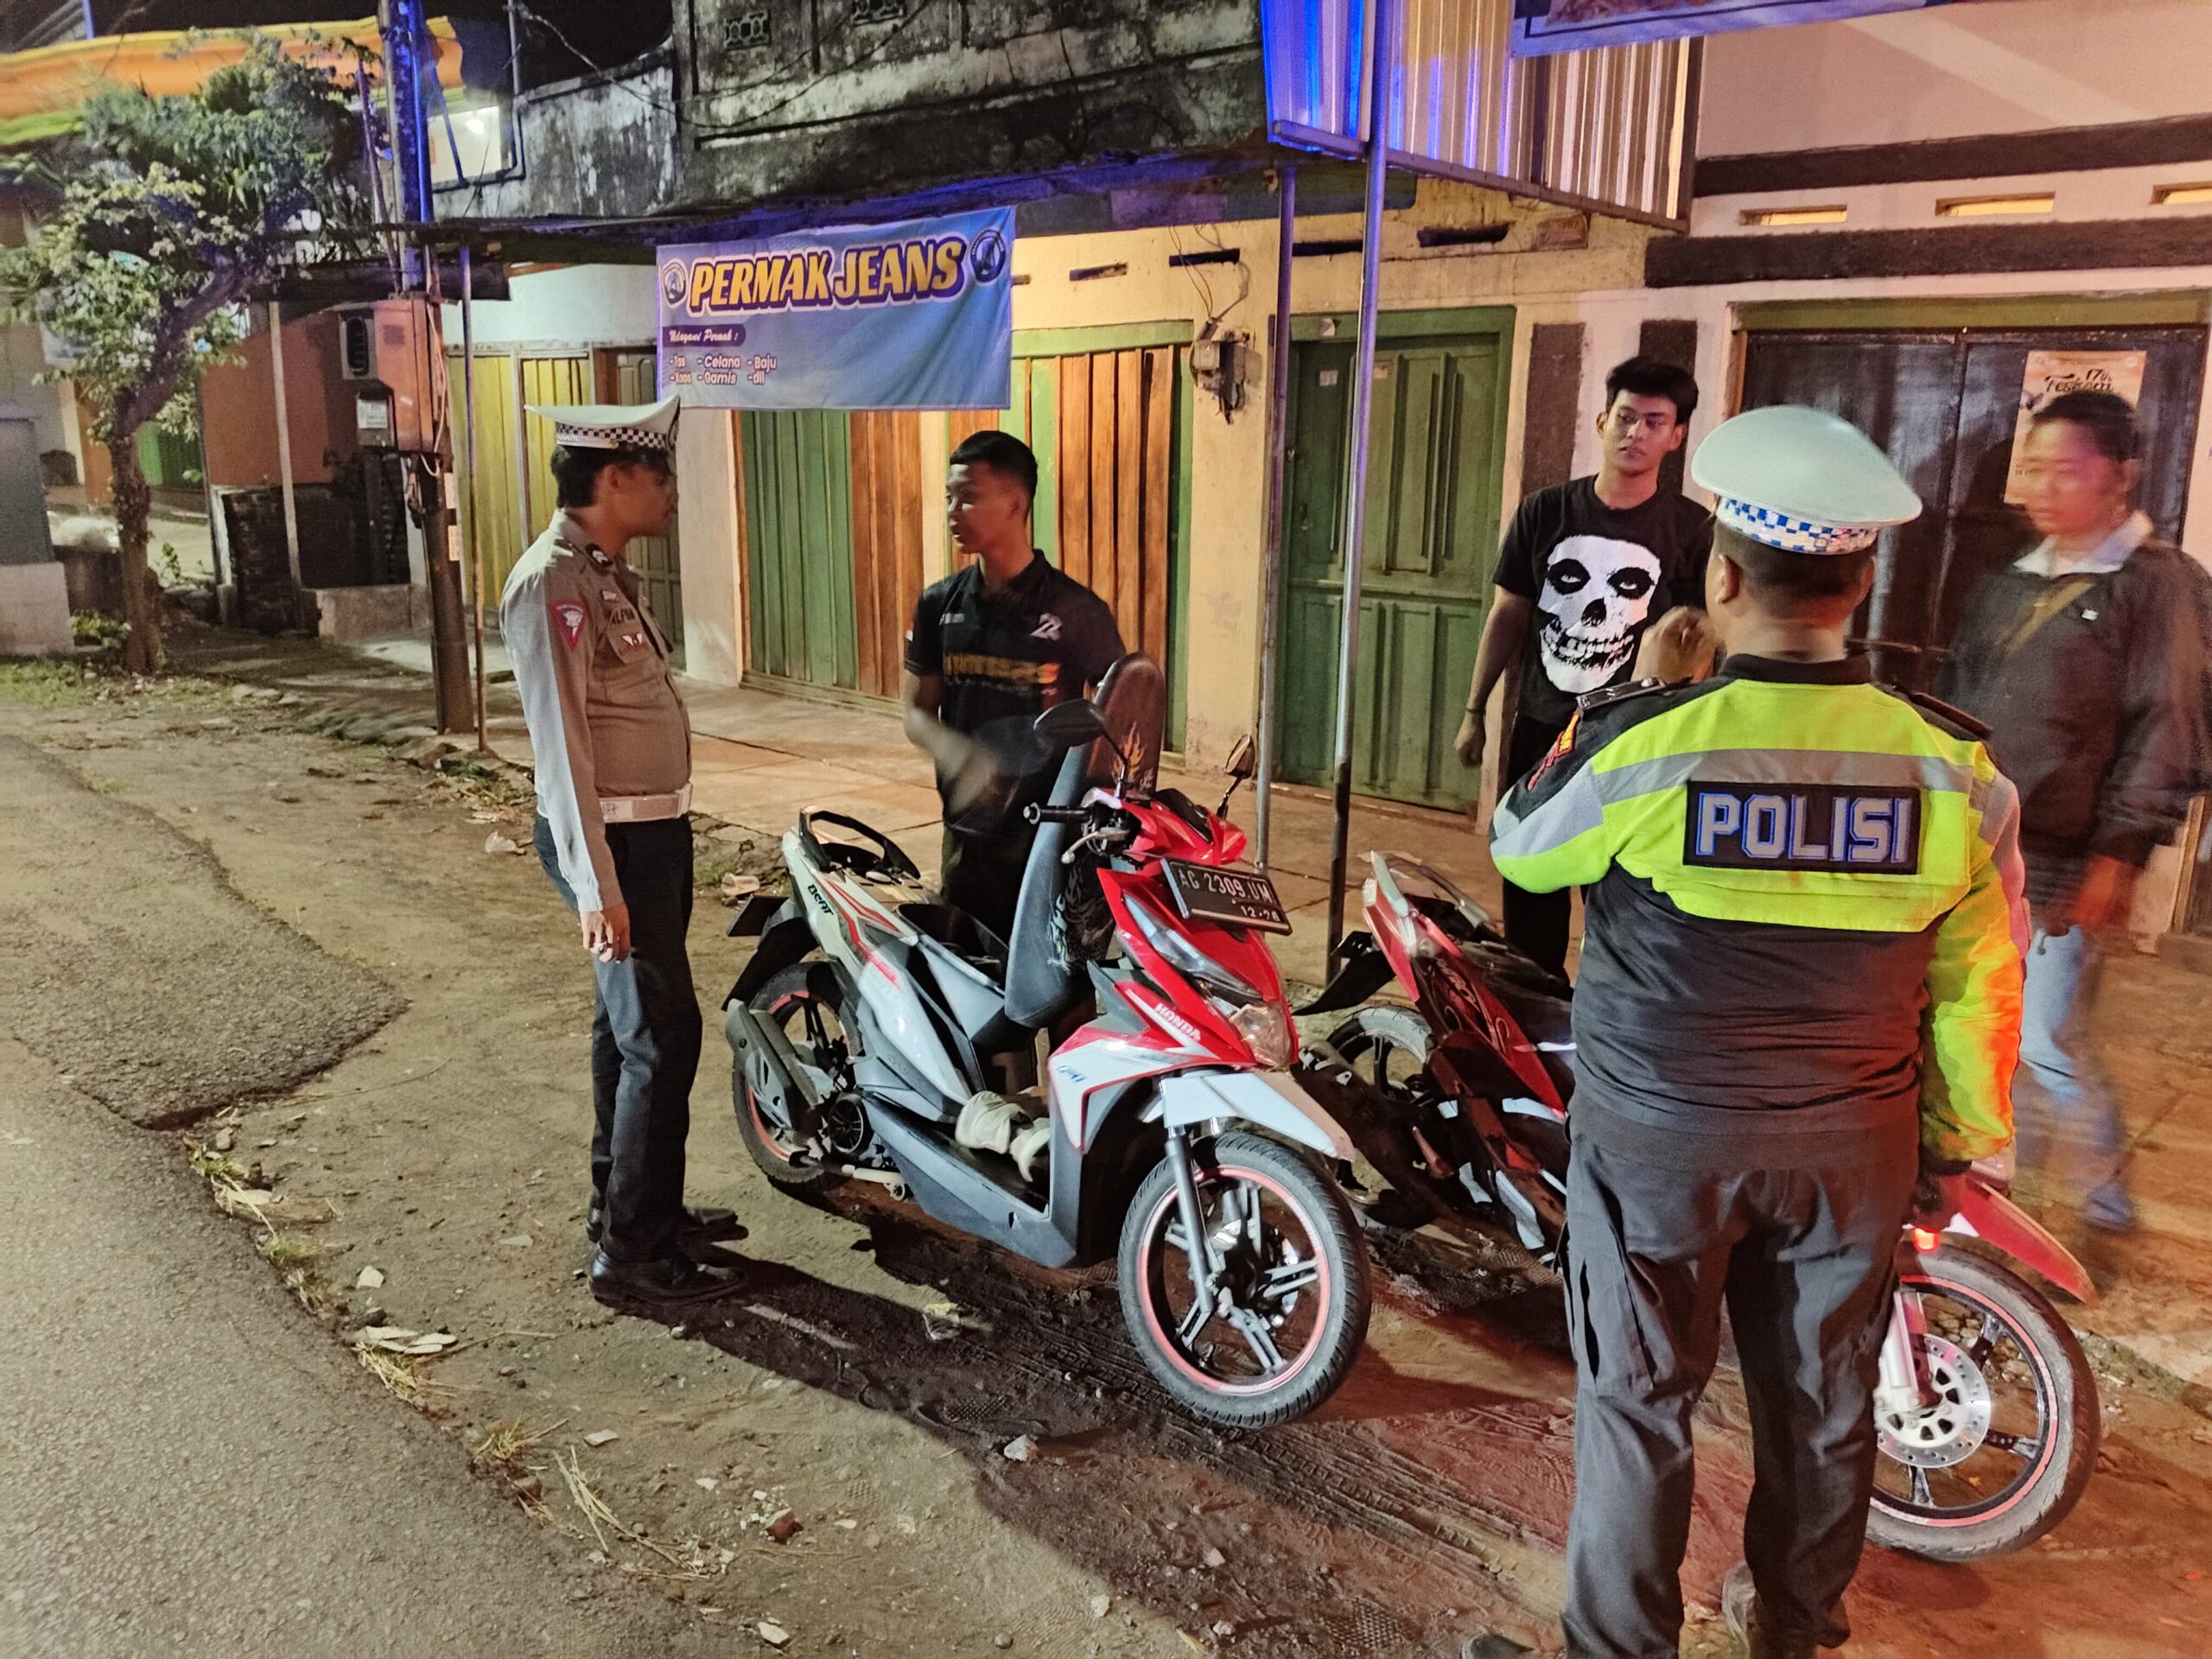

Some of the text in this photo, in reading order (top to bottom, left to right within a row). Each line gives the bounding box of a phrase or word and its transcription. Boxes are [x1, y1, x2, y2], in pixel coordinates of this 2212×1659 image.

[690, 251, 833, 312] PERMAK
[833, 236, 969, 304] JEANS
[1695, 791, 1913, 864] POLISI
[1179, 869, 1200, 890] AG
[1154, 1002, 1202, 1042] HONDA
